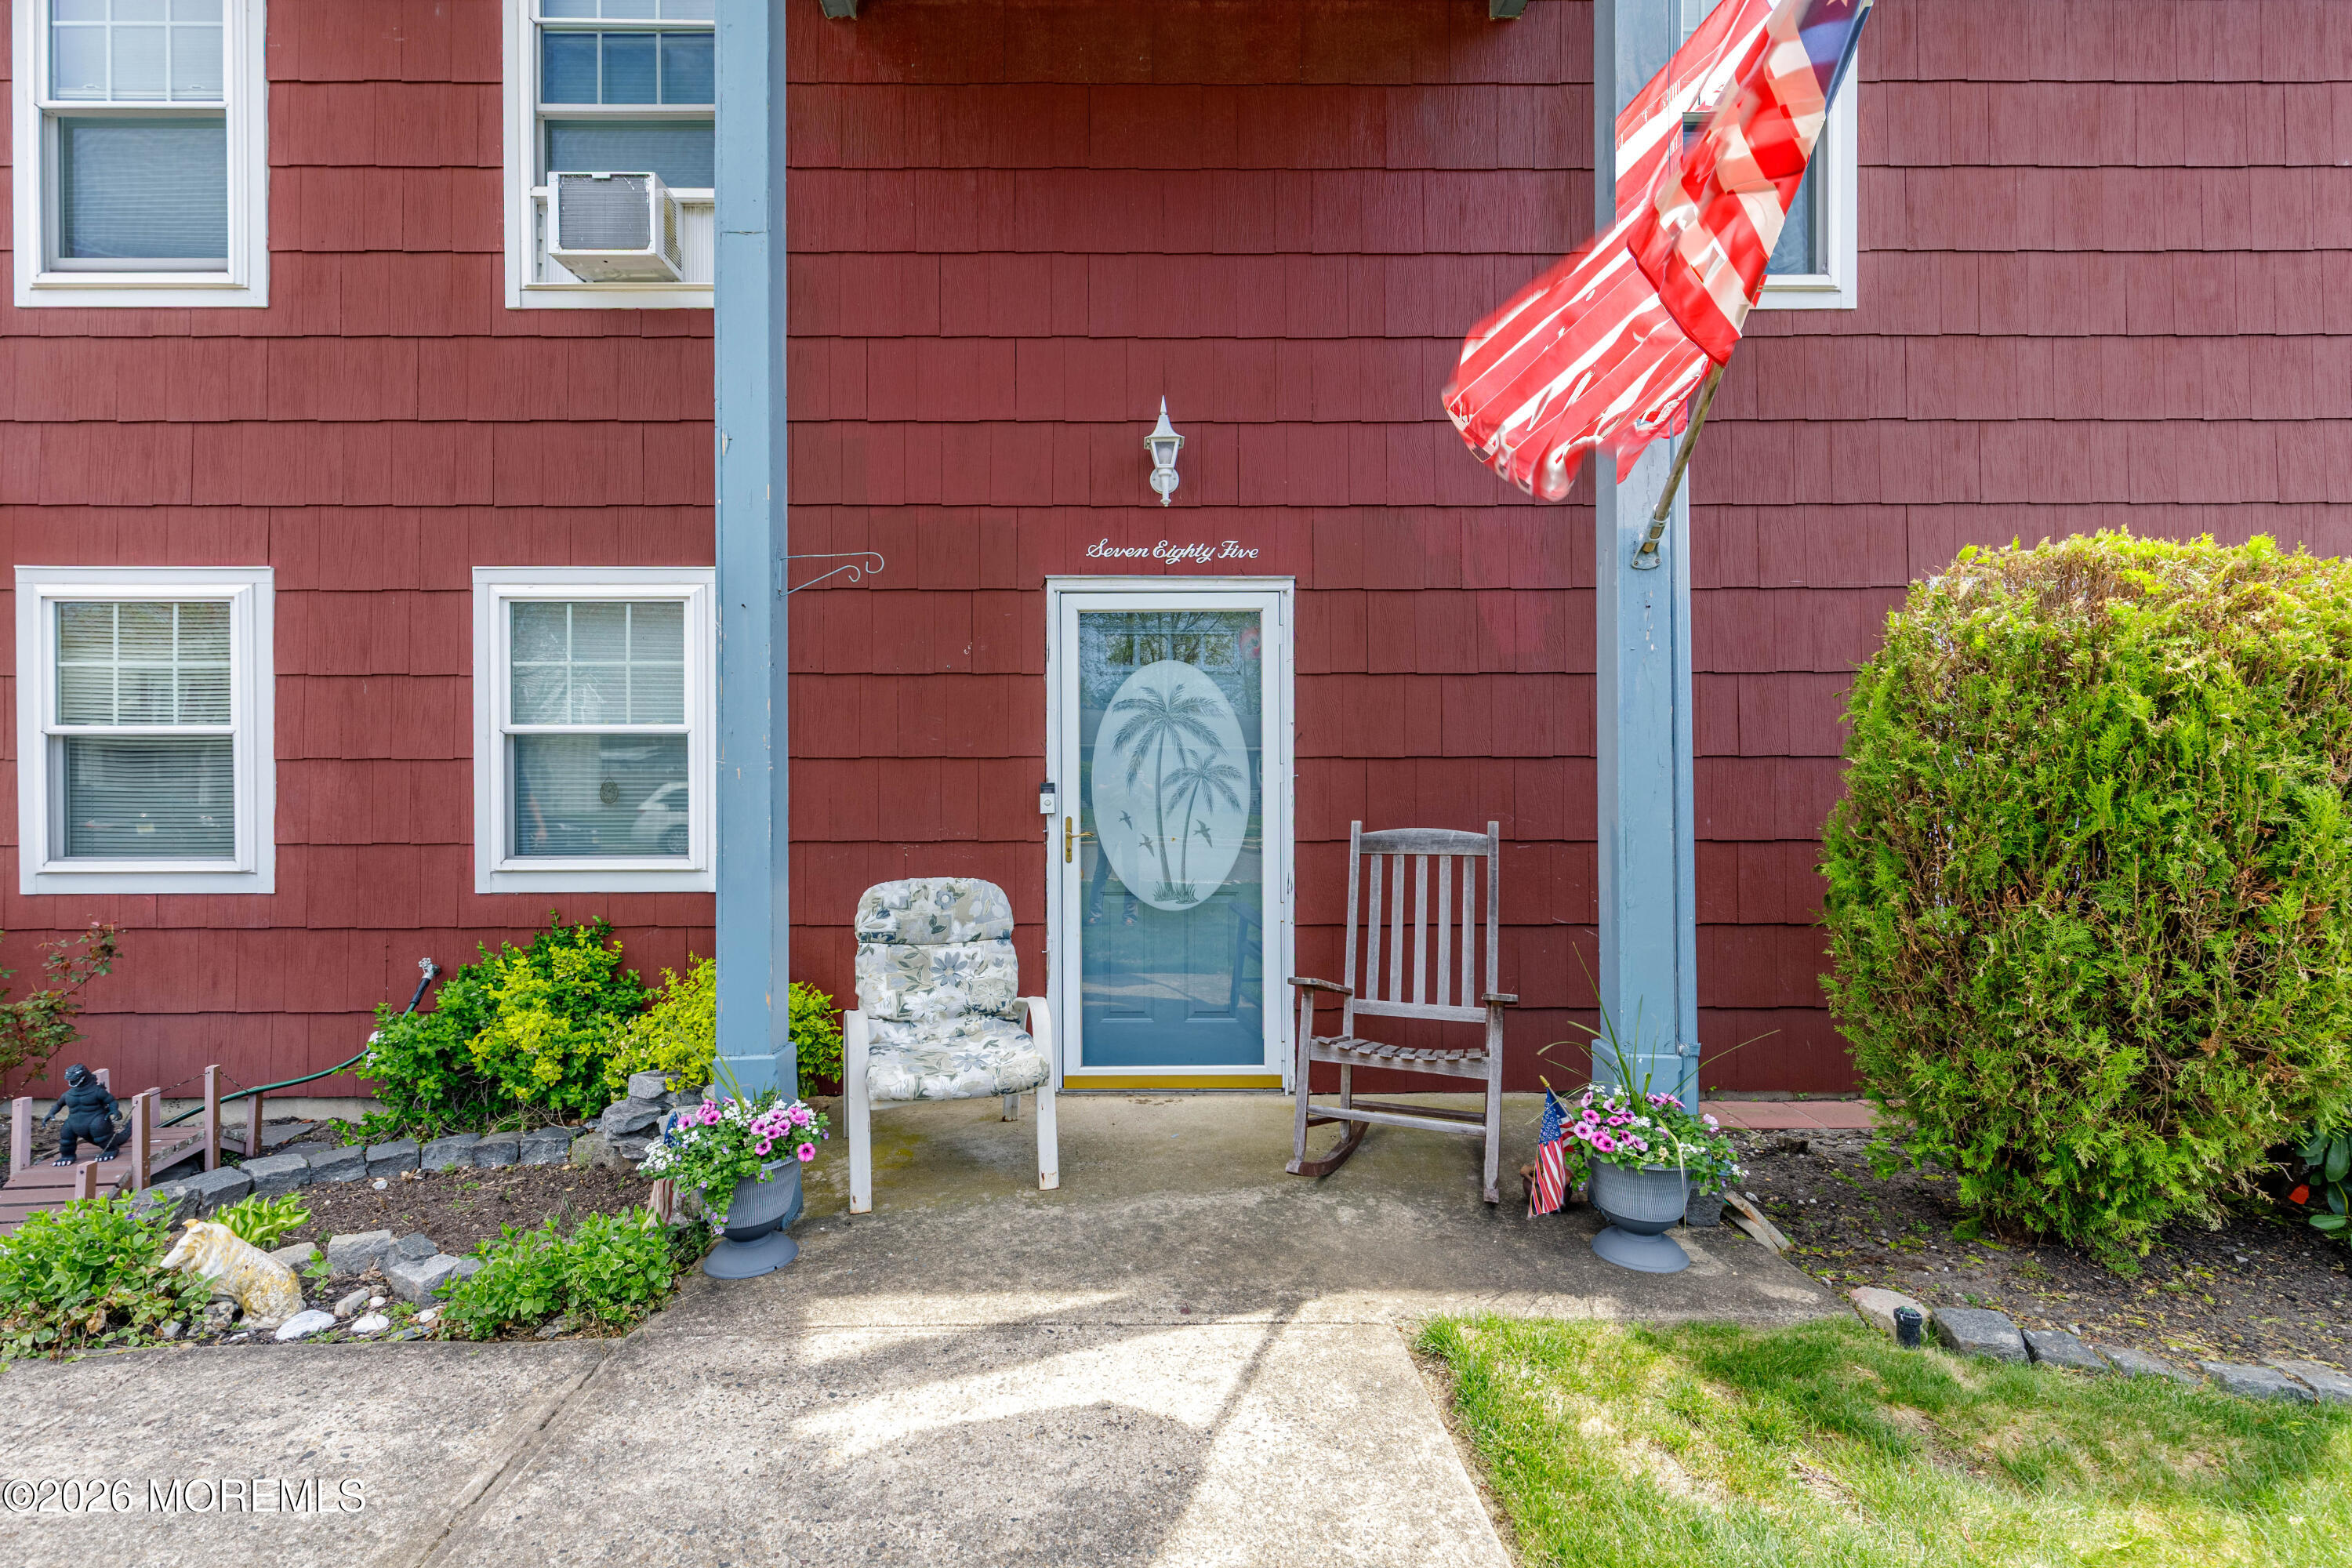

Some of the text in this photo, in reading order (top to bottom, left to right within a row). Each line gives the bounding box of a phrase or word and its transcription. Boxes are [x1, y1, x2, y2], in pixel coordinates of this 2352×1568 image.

[1086, 538, 1258, 564] Seven Eighty Five
